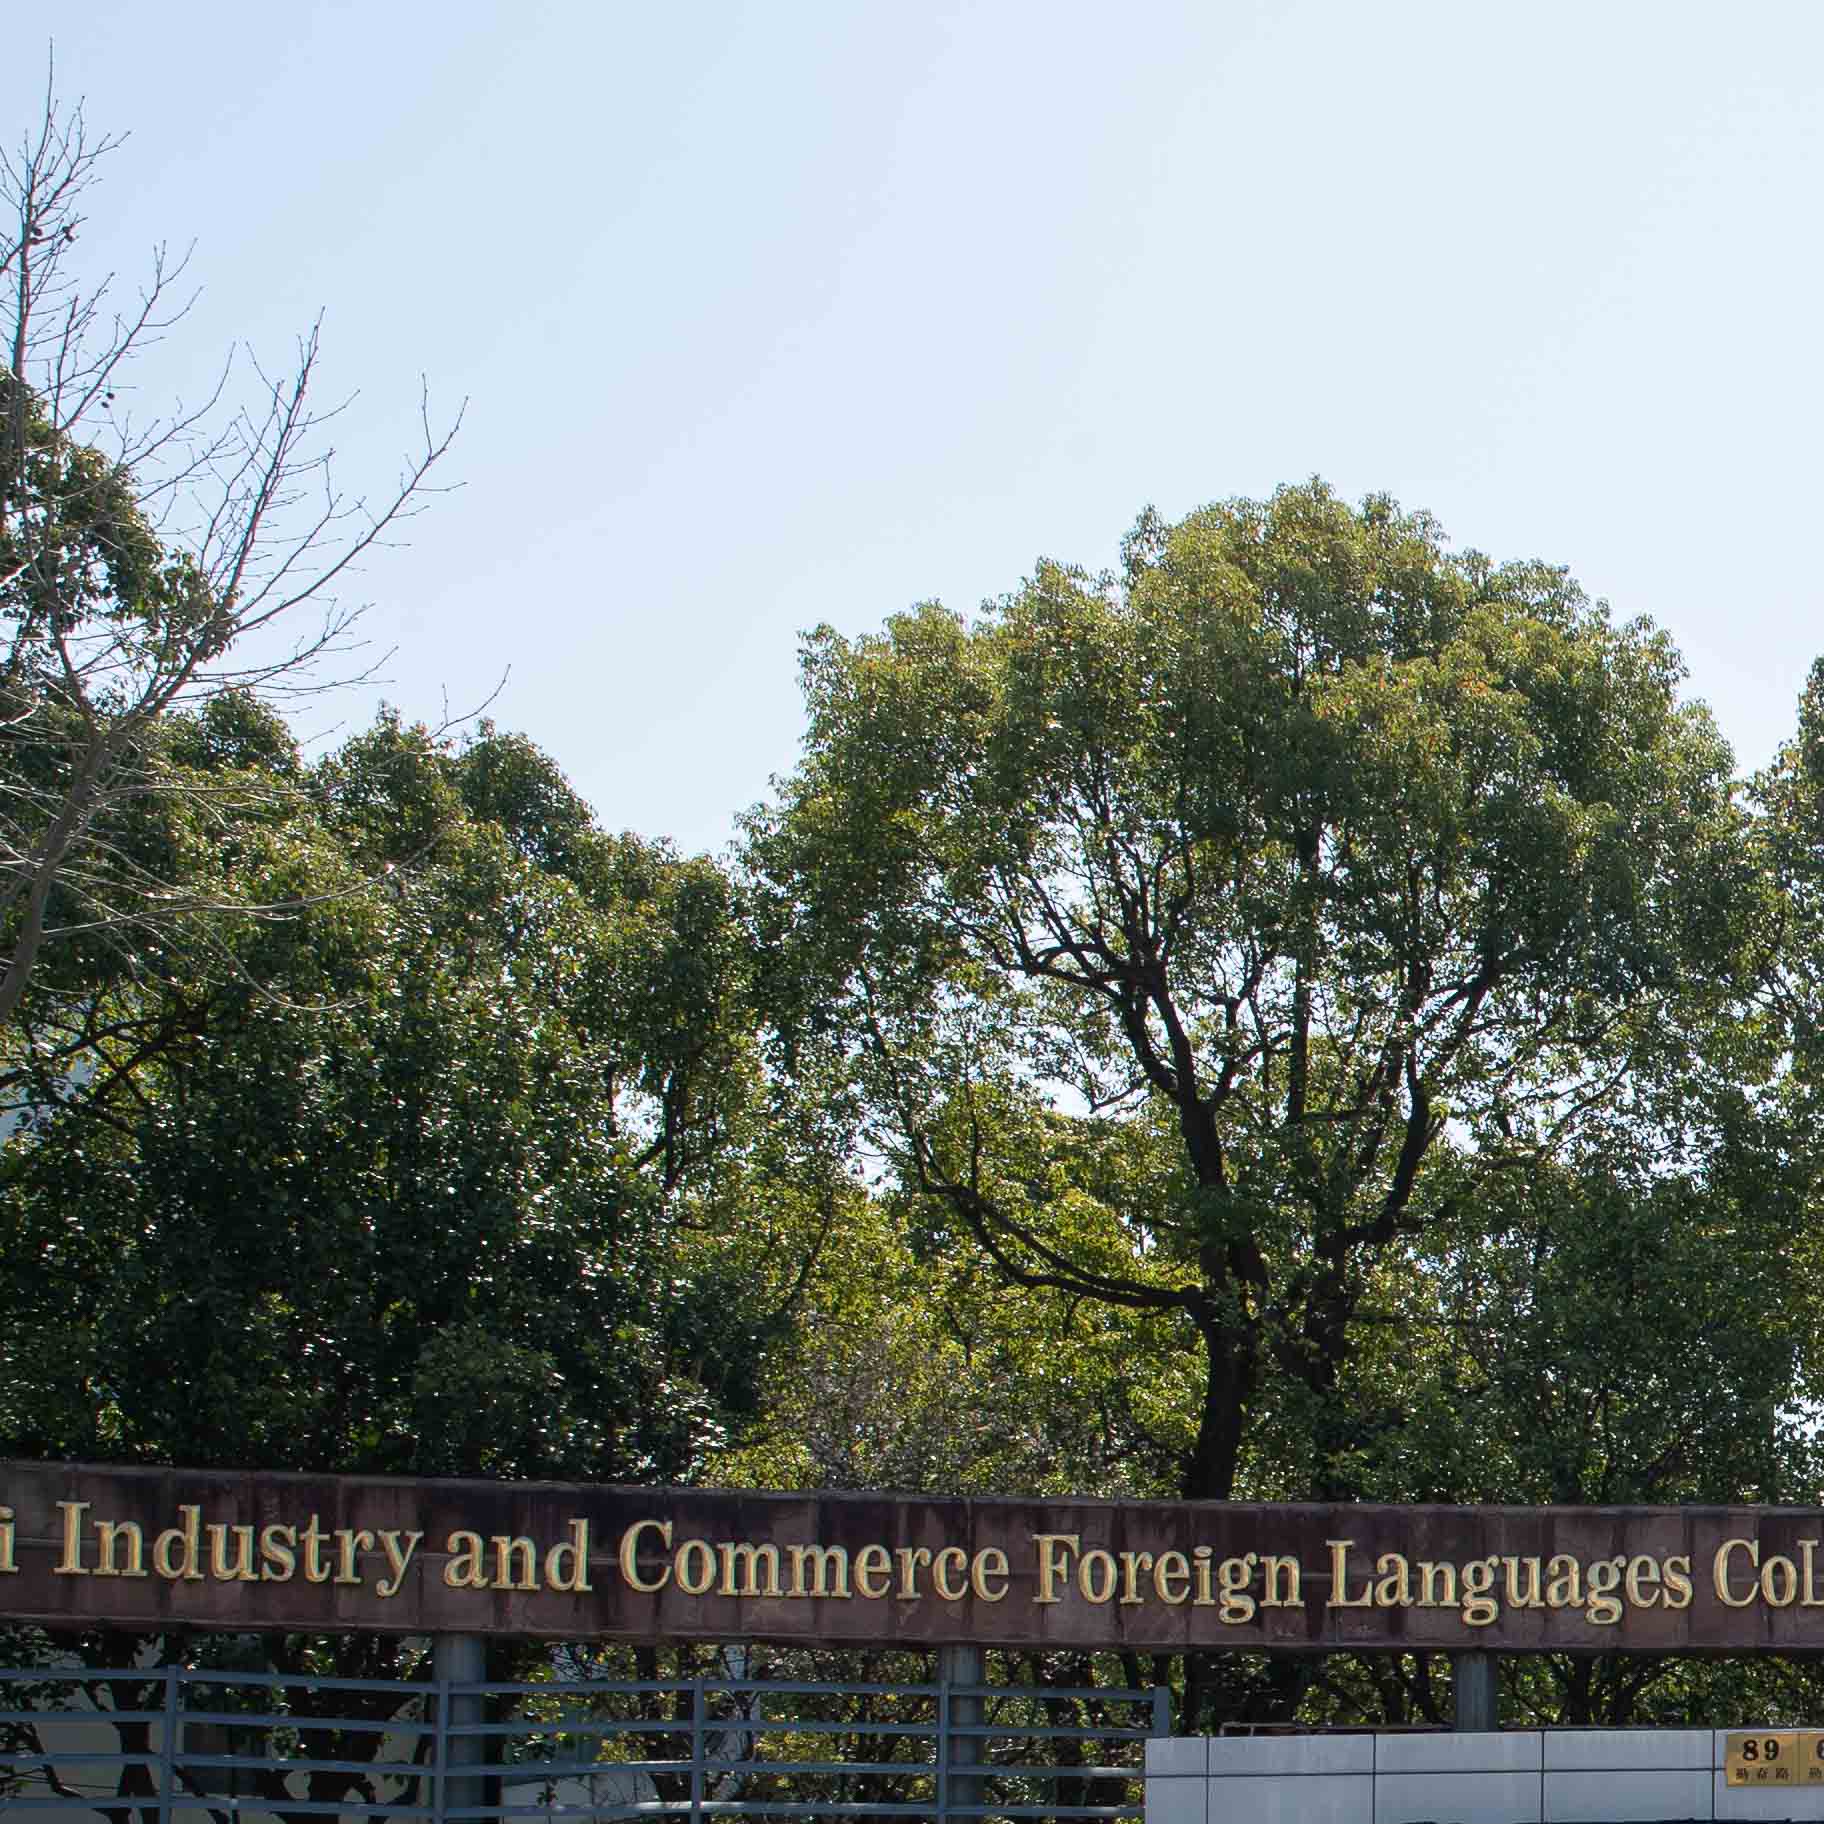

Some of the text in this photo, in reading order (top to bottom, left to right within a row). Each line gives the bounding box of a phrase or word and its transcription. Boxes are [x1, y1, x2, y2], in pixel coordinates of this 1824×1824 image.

[53, 1499, 425, 1599] Industry
[443, 1518, 593, 1593] and
[618, 1518, 1010, 1602] Commerce
[1031, 1533, 1306, 1625] Foreign
[1325, 1539, 1693, 1626] Languages
[1741, 1738, 1781, 1761] 89
